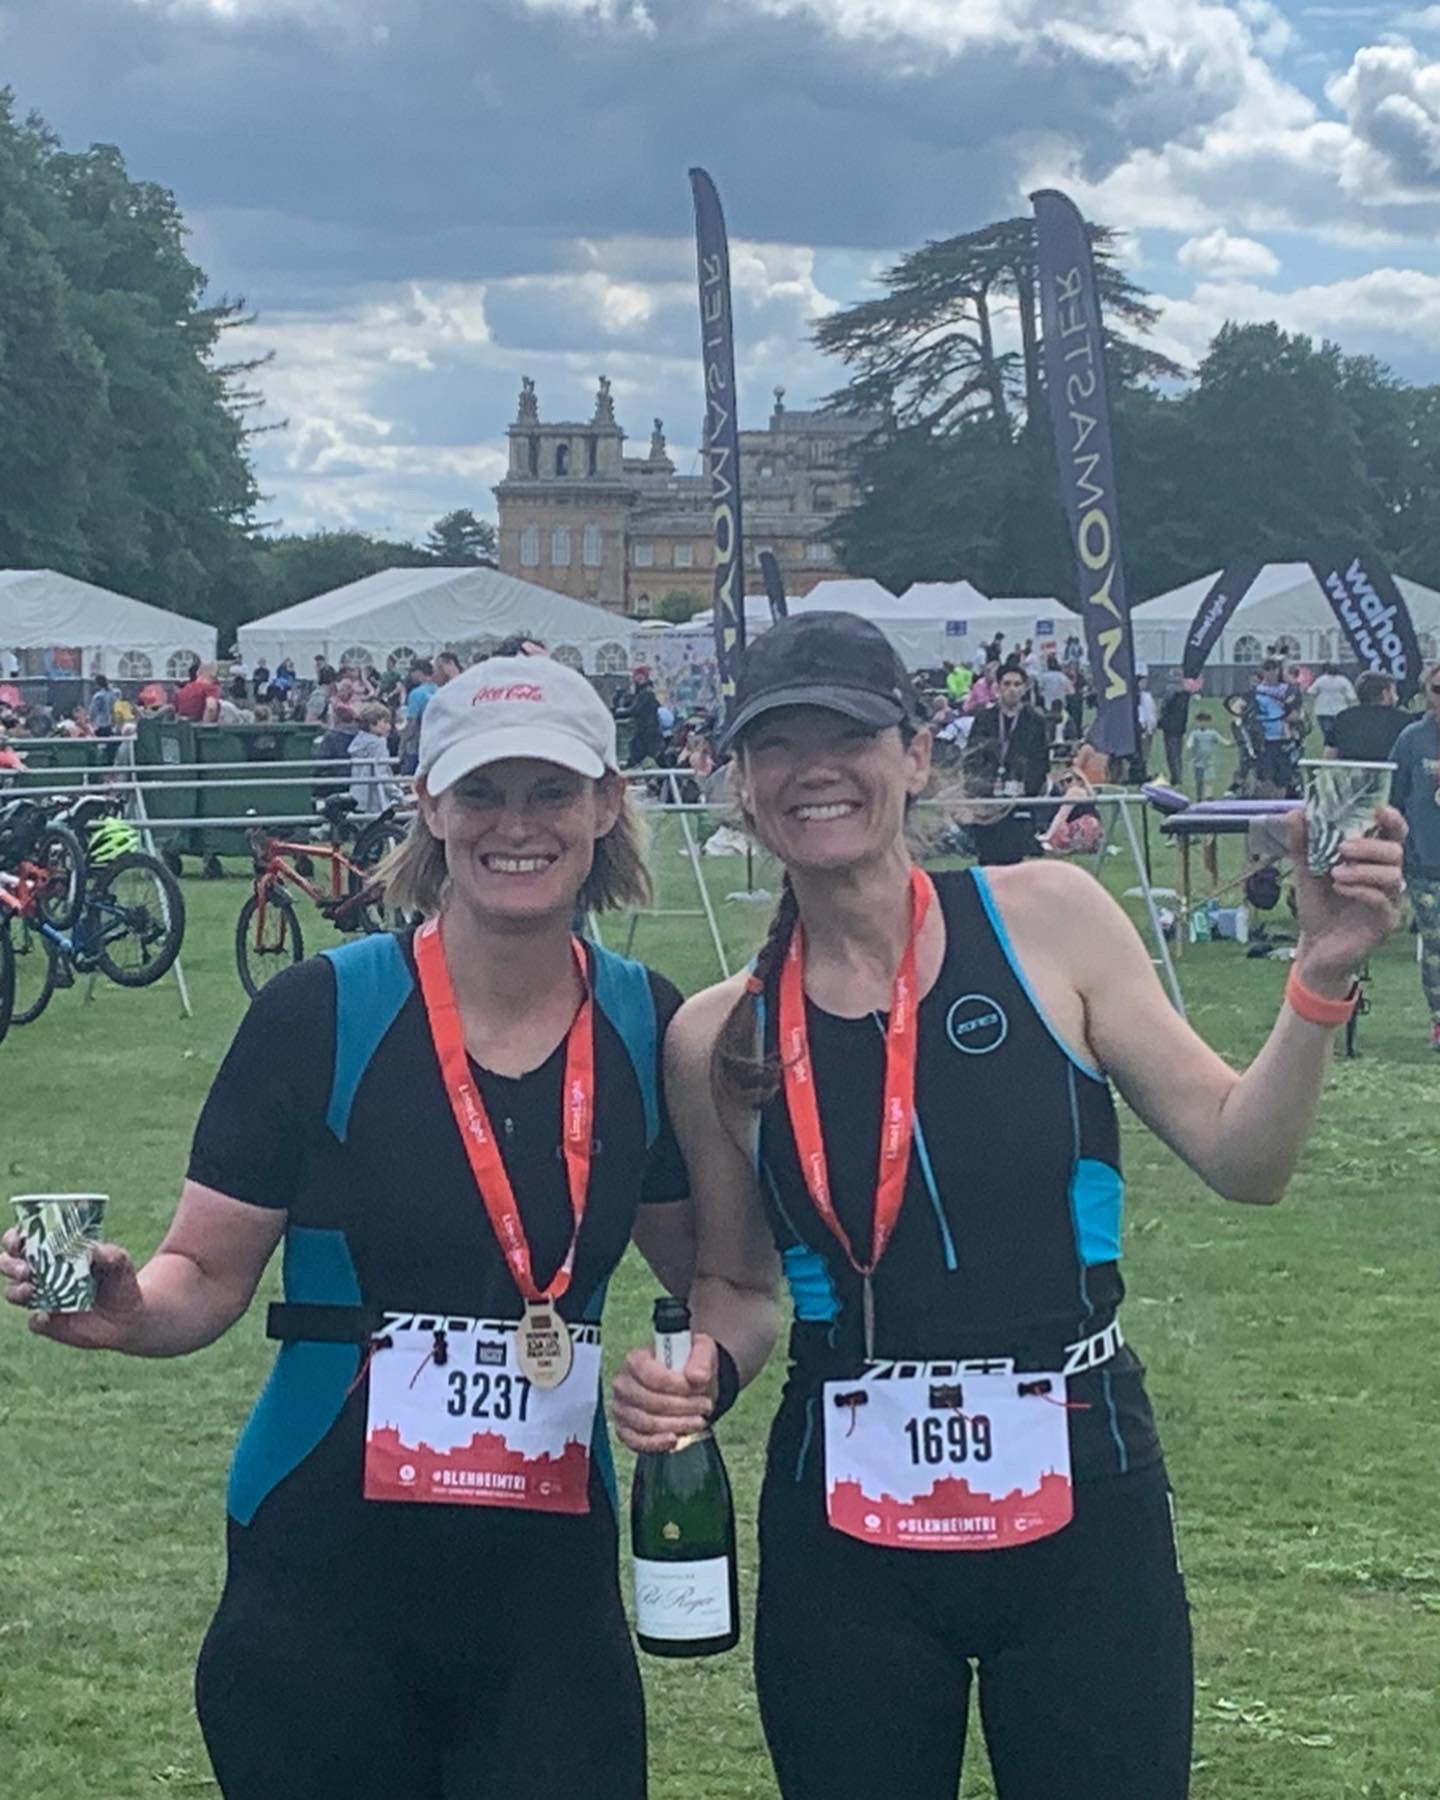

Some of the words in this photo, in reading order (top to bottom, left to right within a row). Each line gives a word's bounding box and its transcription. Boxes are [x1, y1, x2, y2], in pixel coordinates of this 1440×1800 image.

[1345, 557, 1407, 680] wahoo
[447, 1370, 531, 1422] 3237
[904, 1414, 992, 1466] 1699
